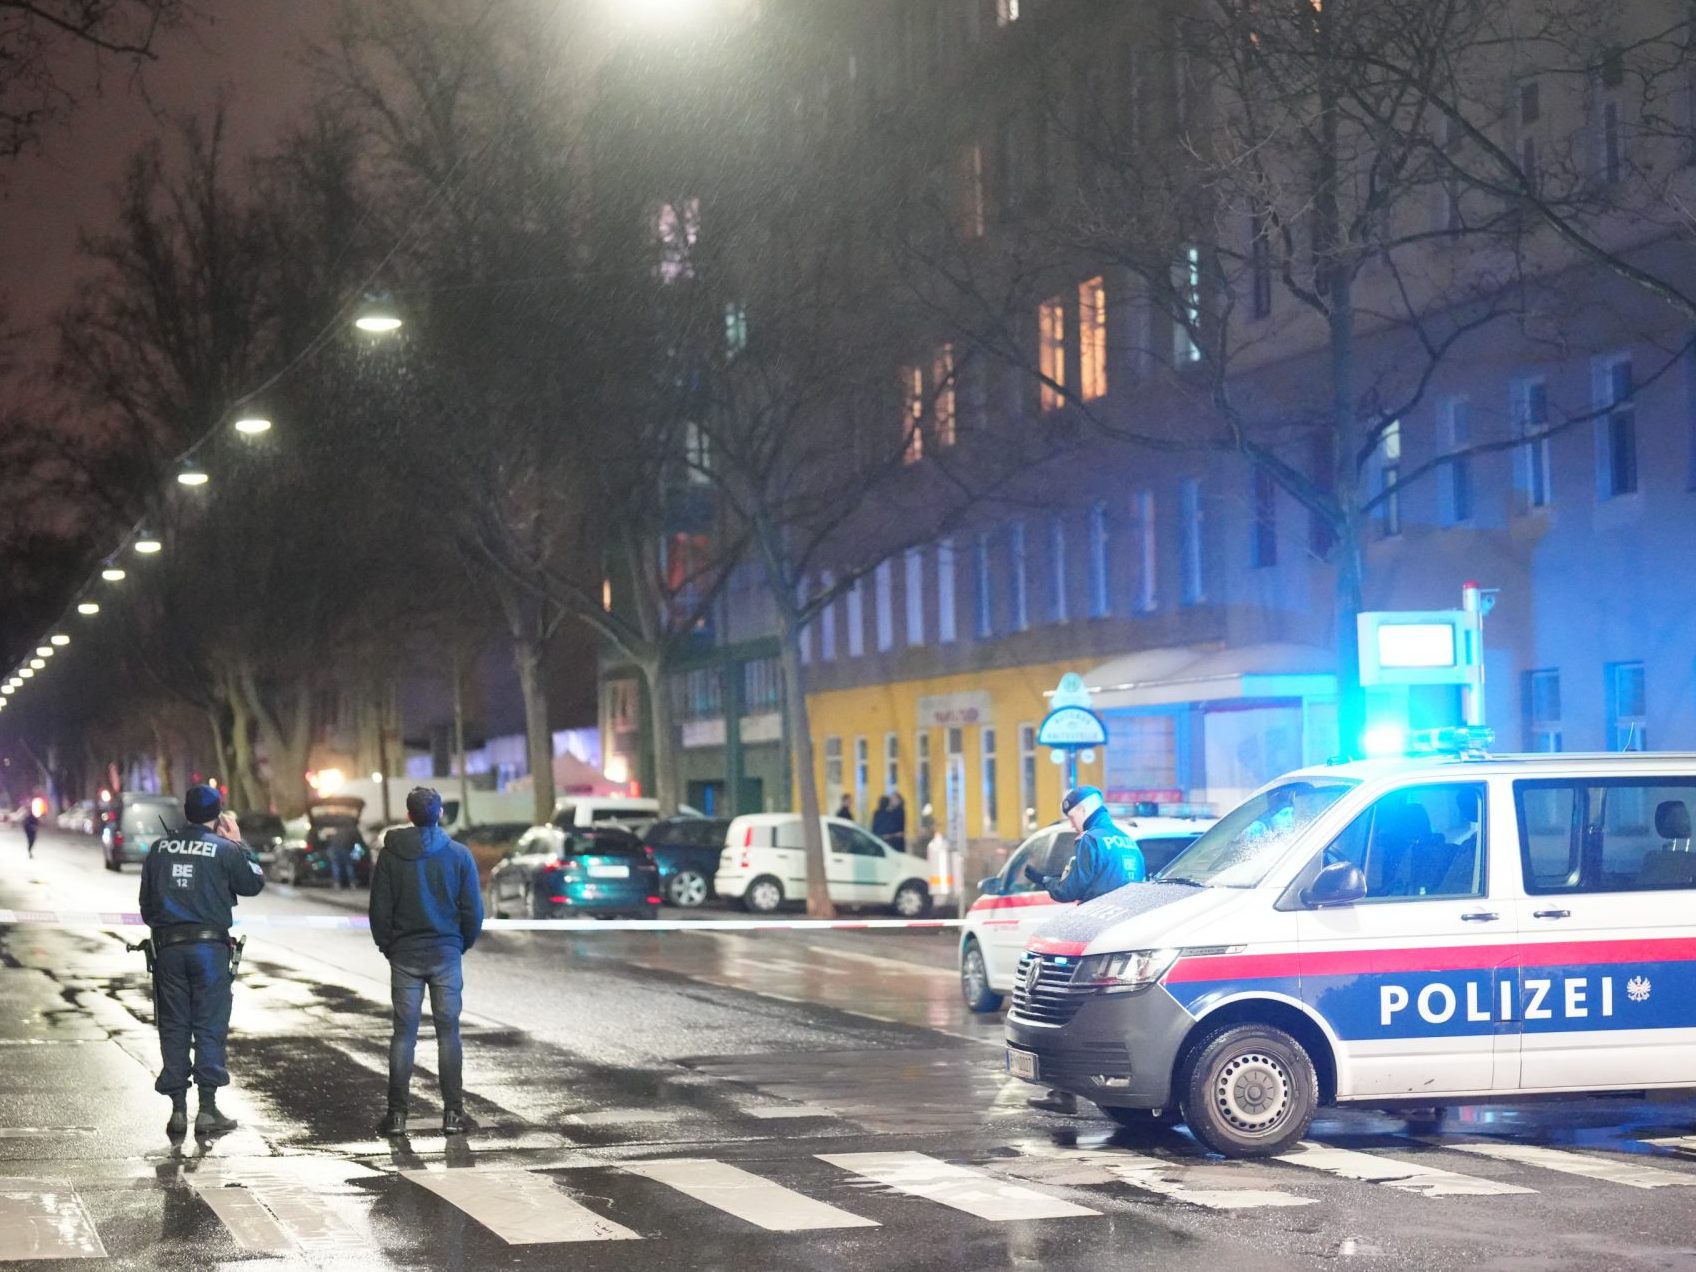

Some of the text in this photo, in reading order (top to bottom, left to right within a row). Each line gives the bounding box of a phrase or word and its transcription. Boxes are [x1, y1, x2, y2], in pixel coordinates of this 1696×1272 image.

[158, 840, 218, 858] POLIZEI
[172, 864, 193, 877] BE
[176, 878, 188, 887] 12
[1380, 976, 1613, 1026] POLIZEI
